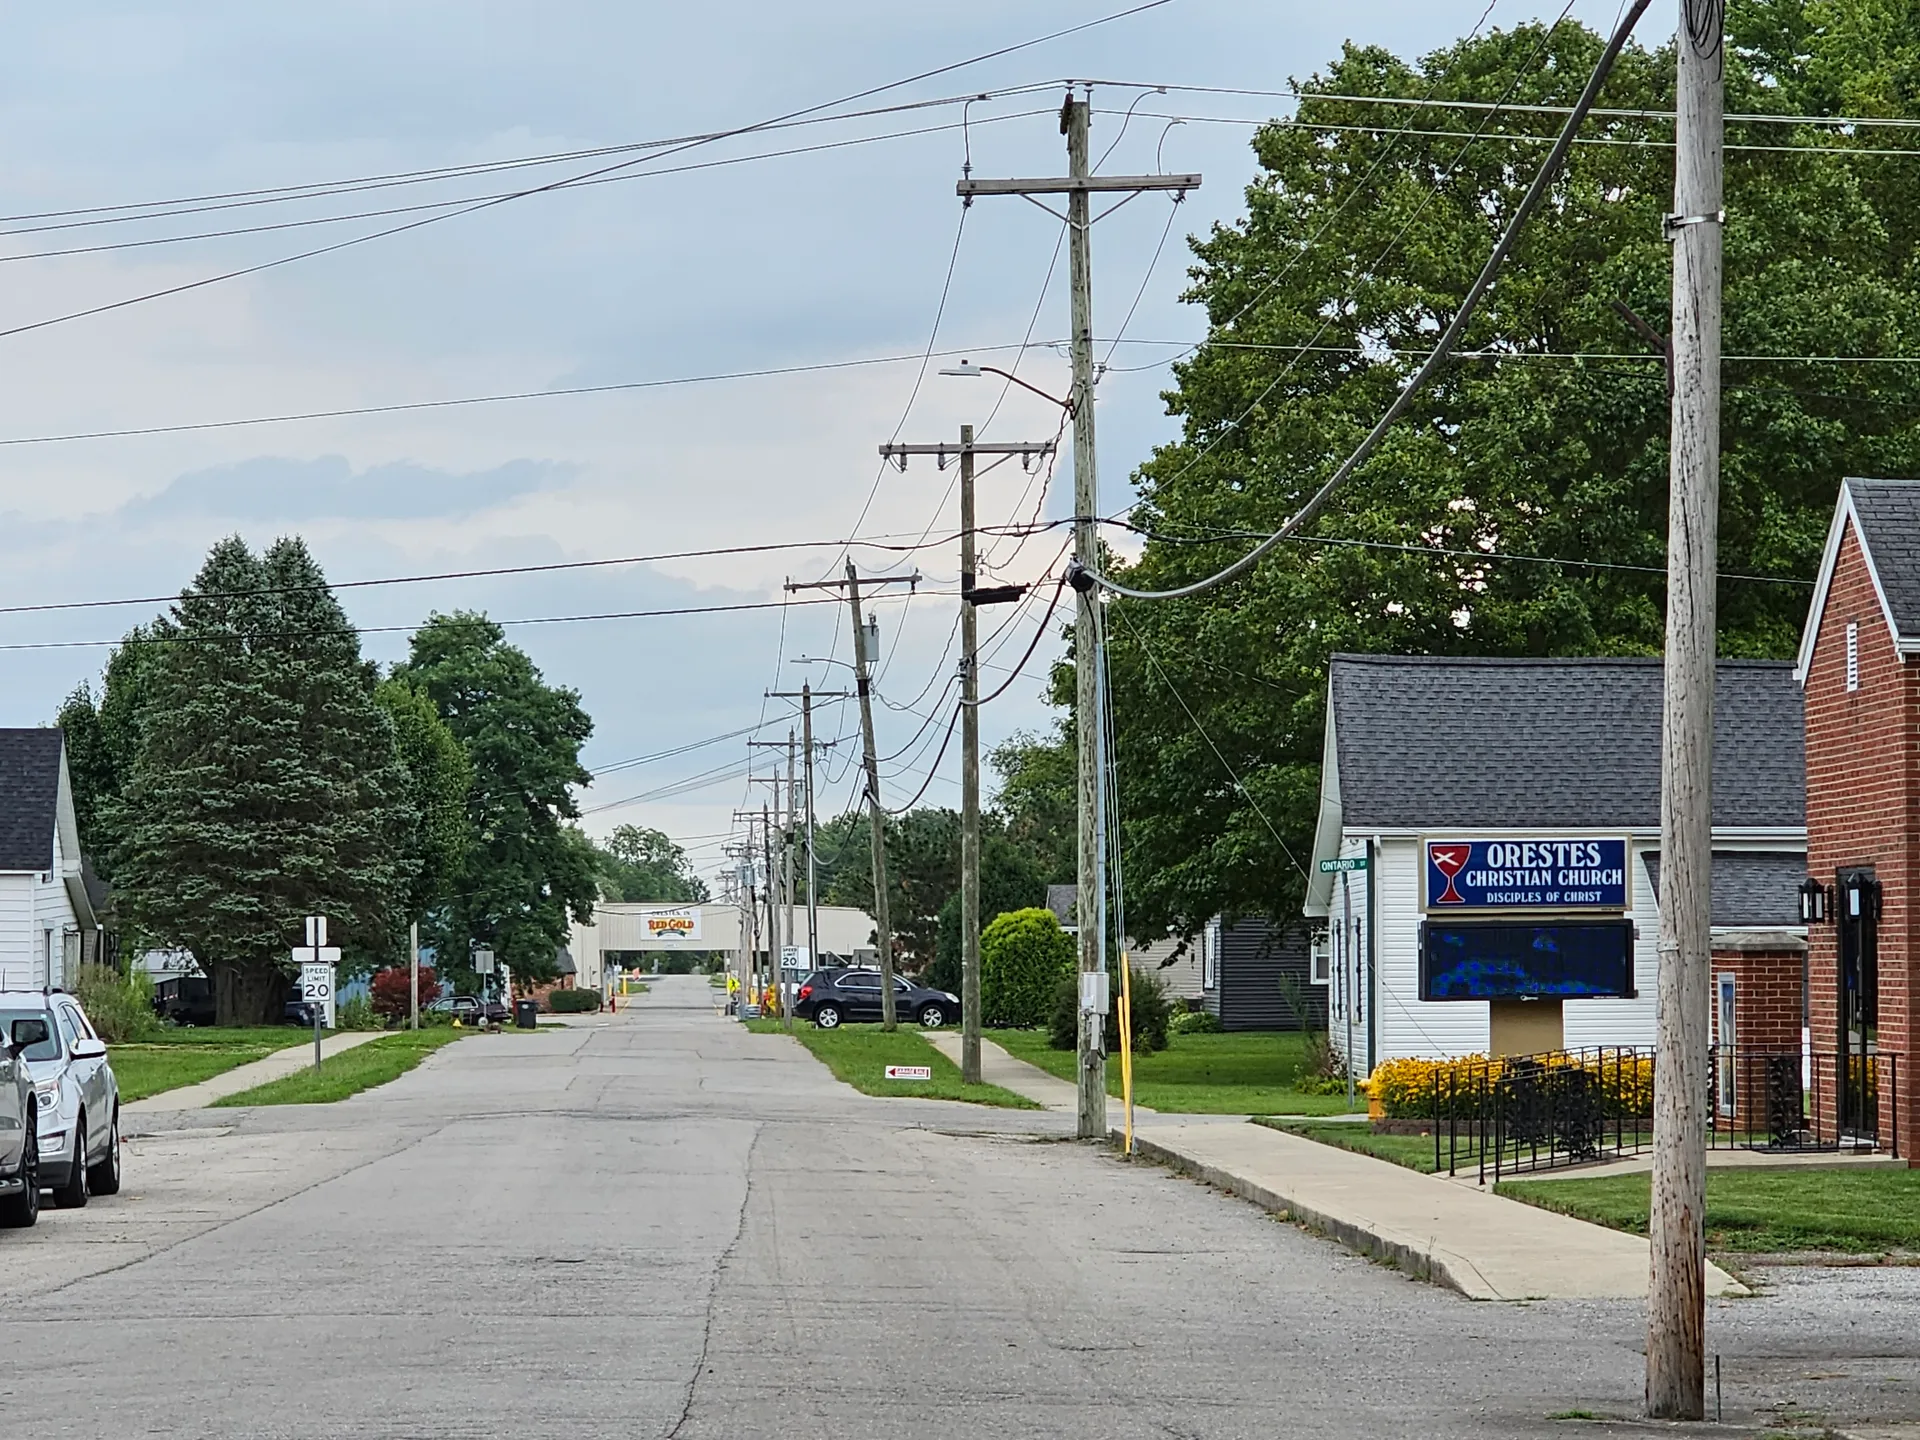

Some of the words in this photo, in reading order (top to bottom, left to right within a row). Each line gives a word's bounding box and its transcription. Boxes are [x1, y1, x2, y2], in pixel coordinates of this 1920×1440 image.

[1486, 842, 1602, 868] ORESTES
[1321, 860, 1355, 871] ONTARIO
[1465, 869, 1552, 887] CHRISTIAN
[1558, 869, 1623, 886] CHURCH
[1486, 891, 1542, 903] DISCIPLES
[1546, 891, 1561, 902] OF
[1564, 891, 1602, 902] CHRIST
[647, 919, 667, 930] RED
[668, 918, 695, 930] GOLD
[783, 957, 797, 966] 20
[305, 984, 329, 997] 20
